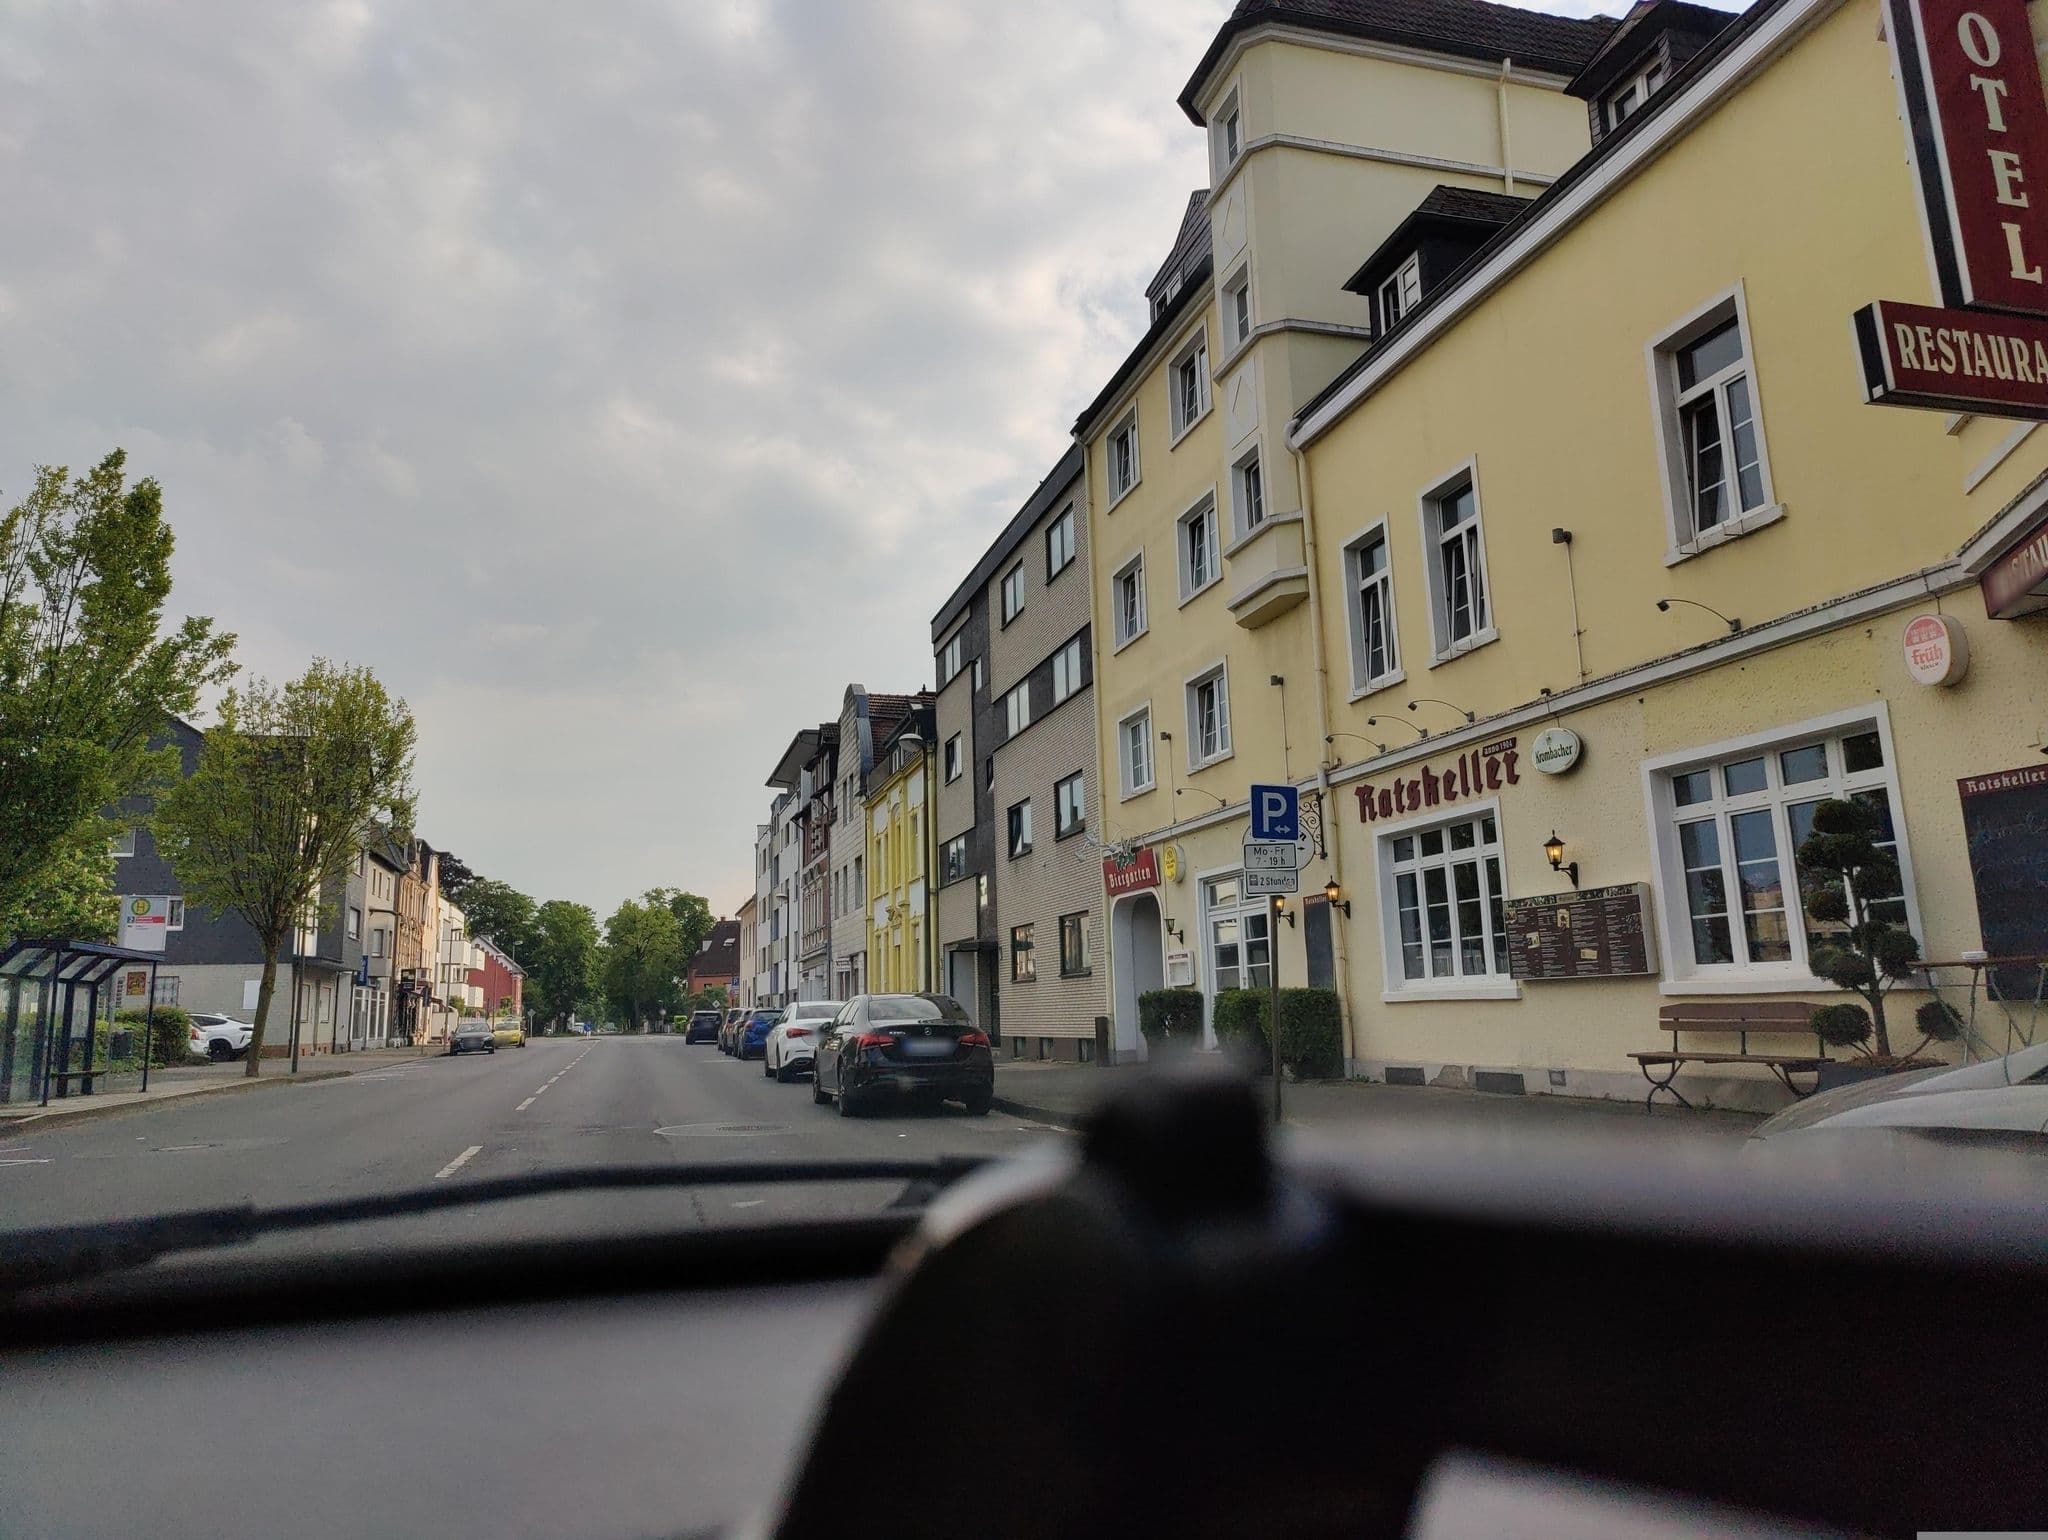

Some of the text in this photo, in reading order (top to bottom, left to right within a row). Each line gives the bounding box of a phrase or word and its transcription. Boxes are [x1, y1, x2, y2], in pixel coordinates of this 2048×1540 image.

[1535, 743, 1574, 764] Krombacher
[1354, 748, 1521, 824] Ratskeller
[1966, 770, 2047, 793] Ratskeller
[1262, 791, 1288, 833] P
[1253, 846, 1268, 856] Mo
[1275, 846, 1286, 856] Fr
[1269, 856, 1278, 866] 19
[1280, 856, 1286, 865] h
[1108, 867, 1152, 888] Biergarten
[1259, 876, 1265, 886] 2
